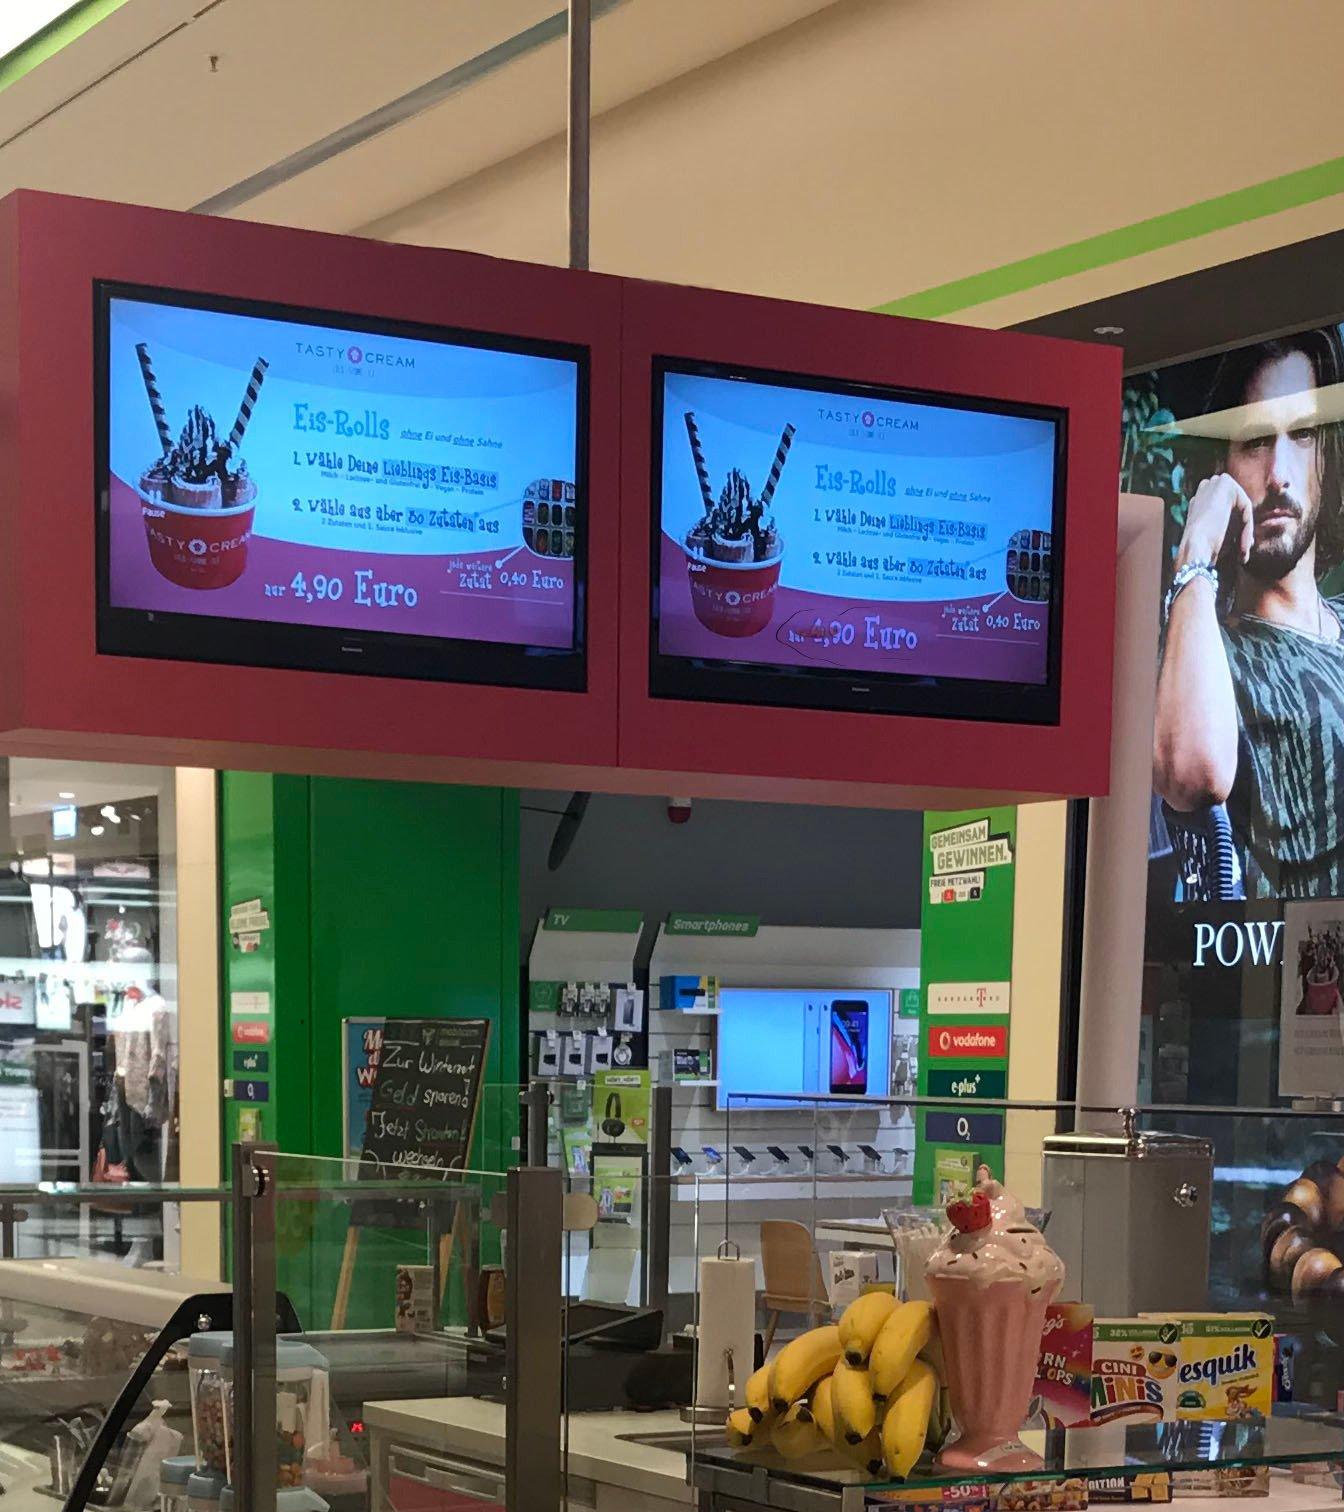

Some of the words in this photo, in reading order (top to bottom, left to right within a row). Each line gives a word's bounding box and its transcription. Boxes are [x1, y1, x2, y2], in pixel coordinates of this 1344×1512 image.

[296, 342, 344, 359] TASTY
[365, 352, 416, 369] CREAM
[293, 402, 390, 441] Eis-Rolls
[818, 407, 859, 425] TASTY
[876, 416, 919, 431] CREAM
[348, 454, 379, 474] Deine
[383, 460, 437, 490] Lieblings
[440, 464, 498, 489] Eis-Basis
[815, 463, 897, 498] Eis-Rolls
[429, 507, 475, 533] Zutaten
[938, 519, 986, 540] Eis-Basis
[290, 571, 344, 604] 4,90
[354, 568, 418, 608] Euro
[532, 569, 564, 589] Euro
[864, 615, 918, 650] Euro
[1013, 612, 1041, 631] Euro
[931, 825, 986, 850] GEMEINSAM
[937, 843, 1008, 870] GEWINNEN.
[553, 914, 570, 926] TV
[673, 918, 750, 932] Smartphones
[1193, 919, 1284, 968] POW
[953, 1032, 996, 1048] vodafone
[382, 1044, 414, 1068] Zur
[371, 1110, 410, 1139] Jetzt
[1101, 1360, 1138, 1376] CINI
[1179, 1343, 1257, 1386] esquik
